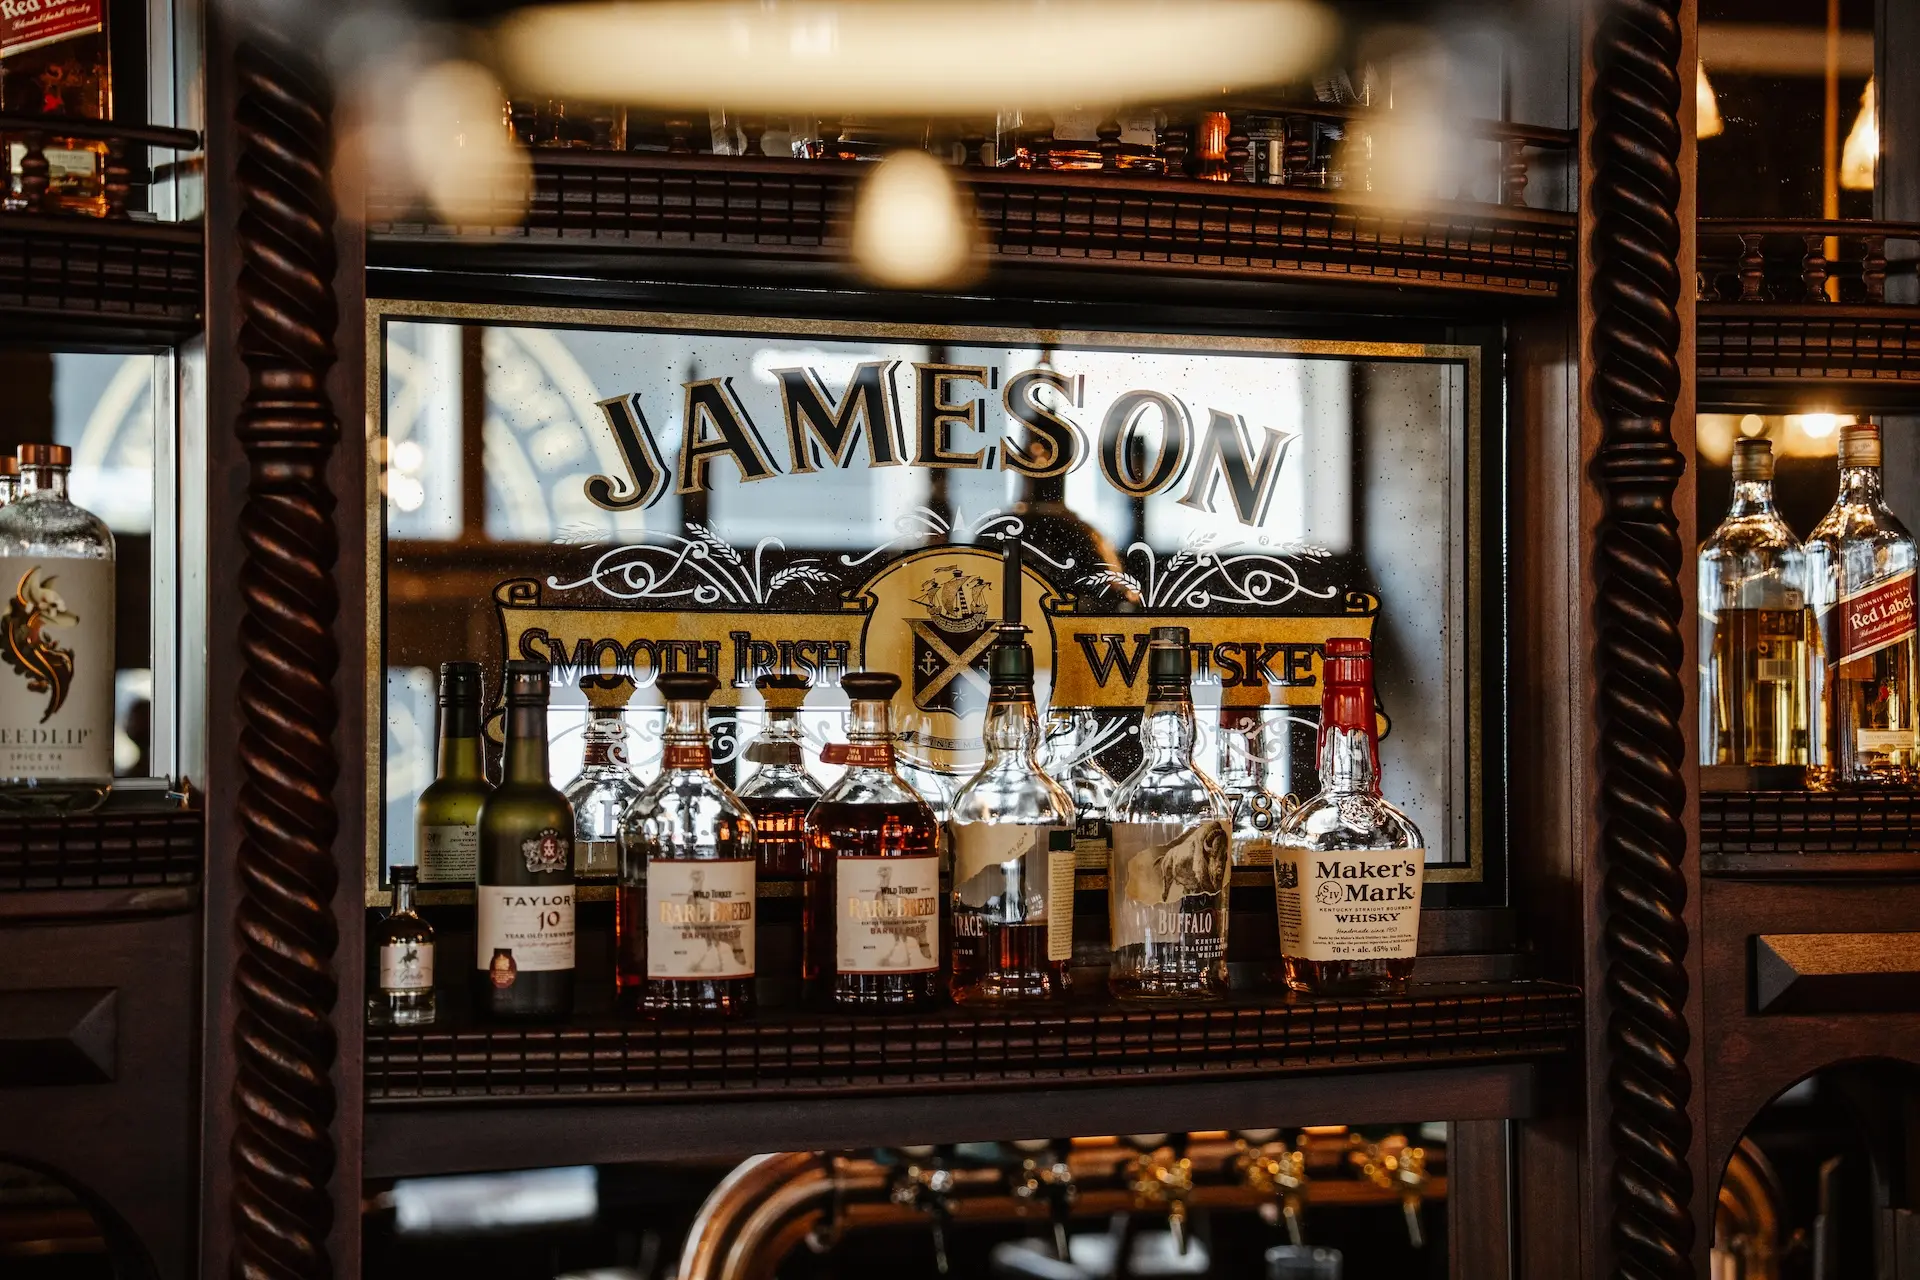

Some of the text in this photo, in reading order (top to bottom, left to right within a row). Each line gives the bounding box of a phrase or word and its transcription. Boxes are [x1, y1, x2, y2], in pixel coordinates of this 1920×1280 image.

[584, 359, 1299, 527] JAMESON
[1856, 585, 1909, 612] JOHNNIE WALKER
[1850, 592, 1914, 630] Red Label
[519, 627, 851, 690] SMOOTH IRISH
[1074, 632, 1326, 688] WISKE
[0, 728, 88, 744] EEDLIP
[1315, 860, 1416, 879] Maker's
[693, 890, 710, 899] WILD
[711, 889, 732, 898] TURKEY
[881, 886, 897, 894] WILD
[898, 885, 918, 894] TURKEY
[1323, 885, 1329, 893] S
[1329, 891, 1340, 899] IV
[1344, 883, 1414, 902] Mark
[658, 901, 752, 923] RARE BREED
[848, 896, 936, 918] RARE BREED
[537, 911, 560, 930] 10
[954, 912, 984, 938] TRACE
[1158, 909, 1212, 935] BUFFALO
[1335, 912, 1401, 923] WHISKY
[1390, 944, 1402, 952] vol.
